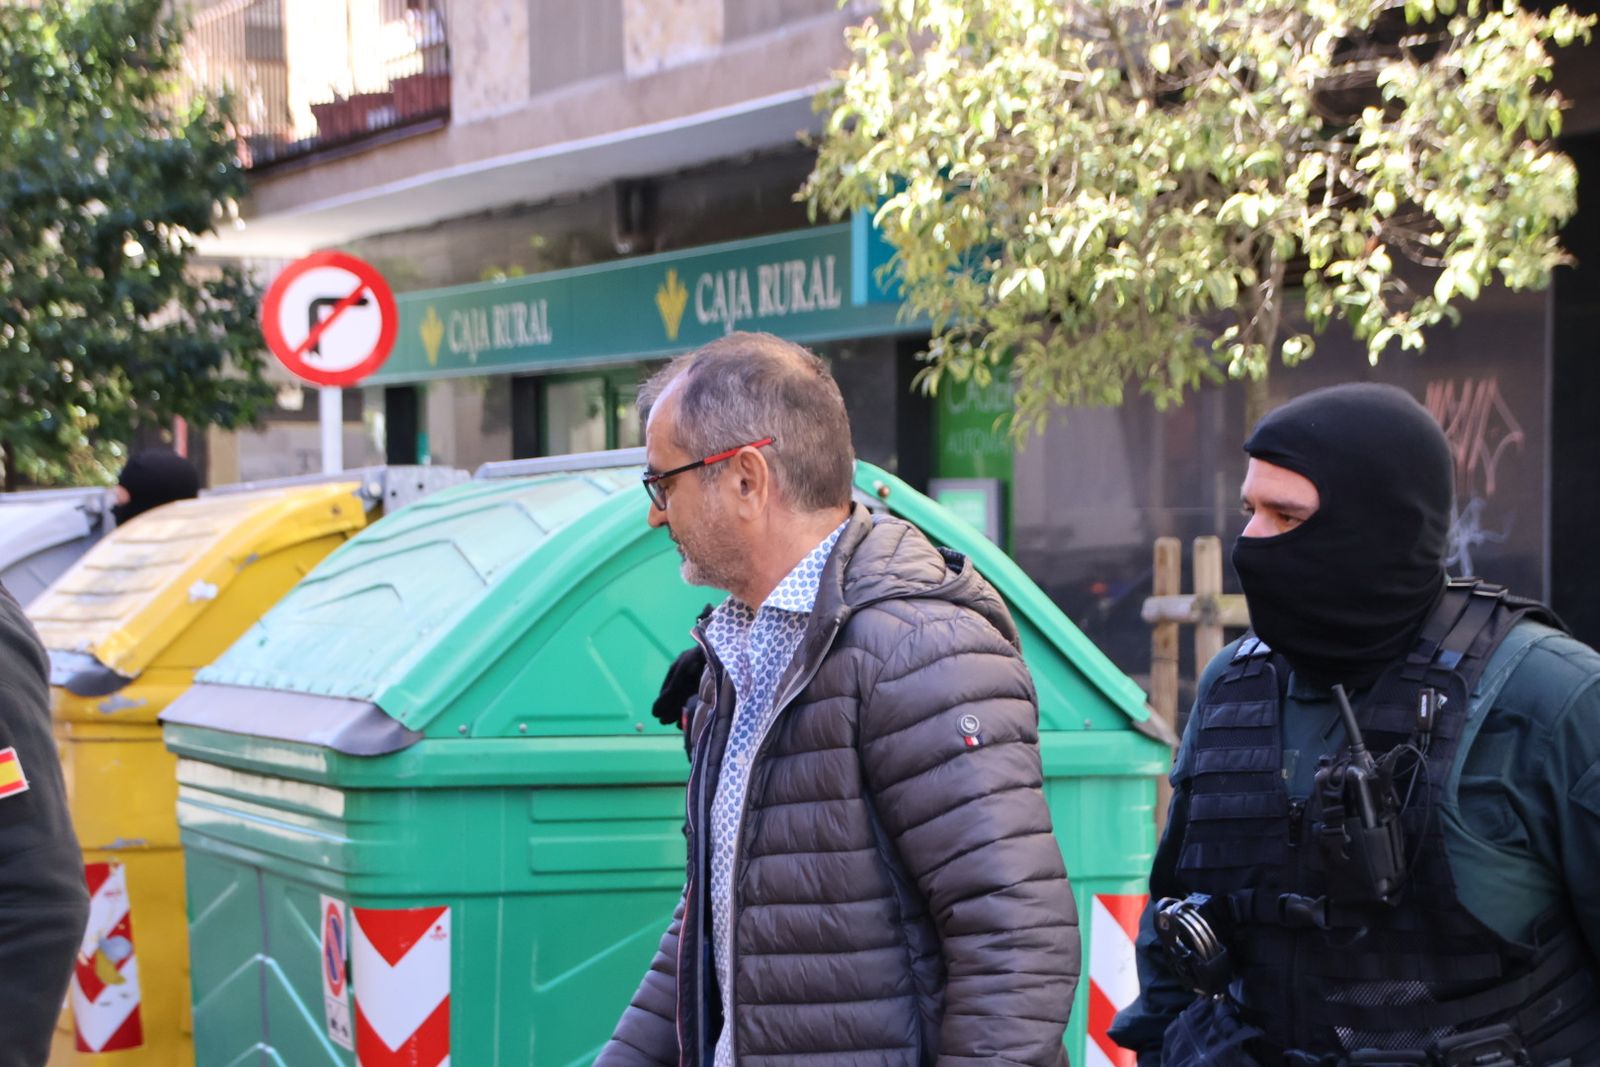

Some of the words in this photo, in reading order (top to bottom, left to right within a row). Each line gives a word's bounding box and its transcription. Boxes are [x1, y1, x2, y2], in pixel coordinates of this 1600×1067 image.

[448, 307, 491, 364] CAJA
[492, 298, 553, 350] RURAL
[696, 265, 753, 336] CAJA
[757, 254, 842, 318] RURAL
